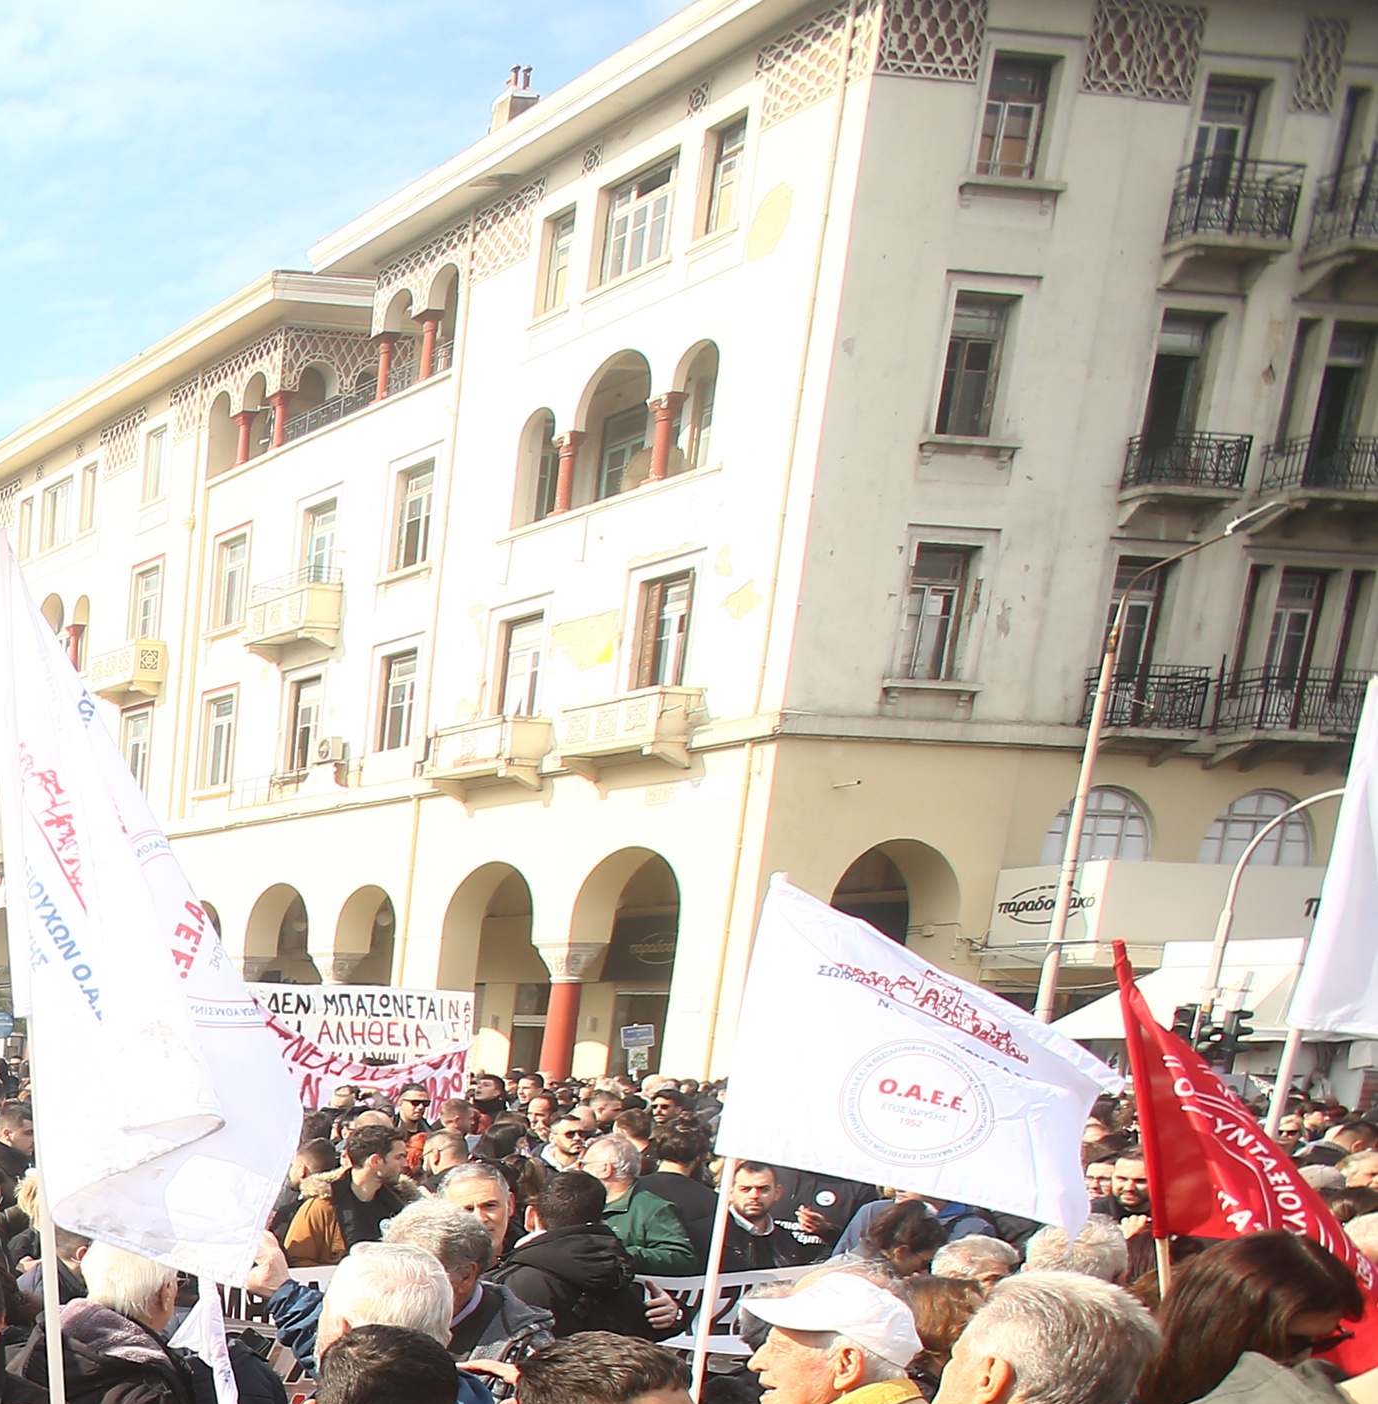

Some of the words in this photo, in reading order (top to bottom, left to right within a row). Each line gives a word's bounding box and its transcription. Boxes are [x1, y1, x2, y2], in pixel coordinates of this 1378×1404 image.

[268, 992, 311, 1014] ΔΕΝ
[317, 1020, 432, 1049] ΑΛΗΘΕΙΑ
[878, 1078, 968, 1114] Ο.Α.Ε.Ε.
[880, 1102, 908, 1115] ΕΤΟΣ
[899, 1116, 923, 1128] 1952
